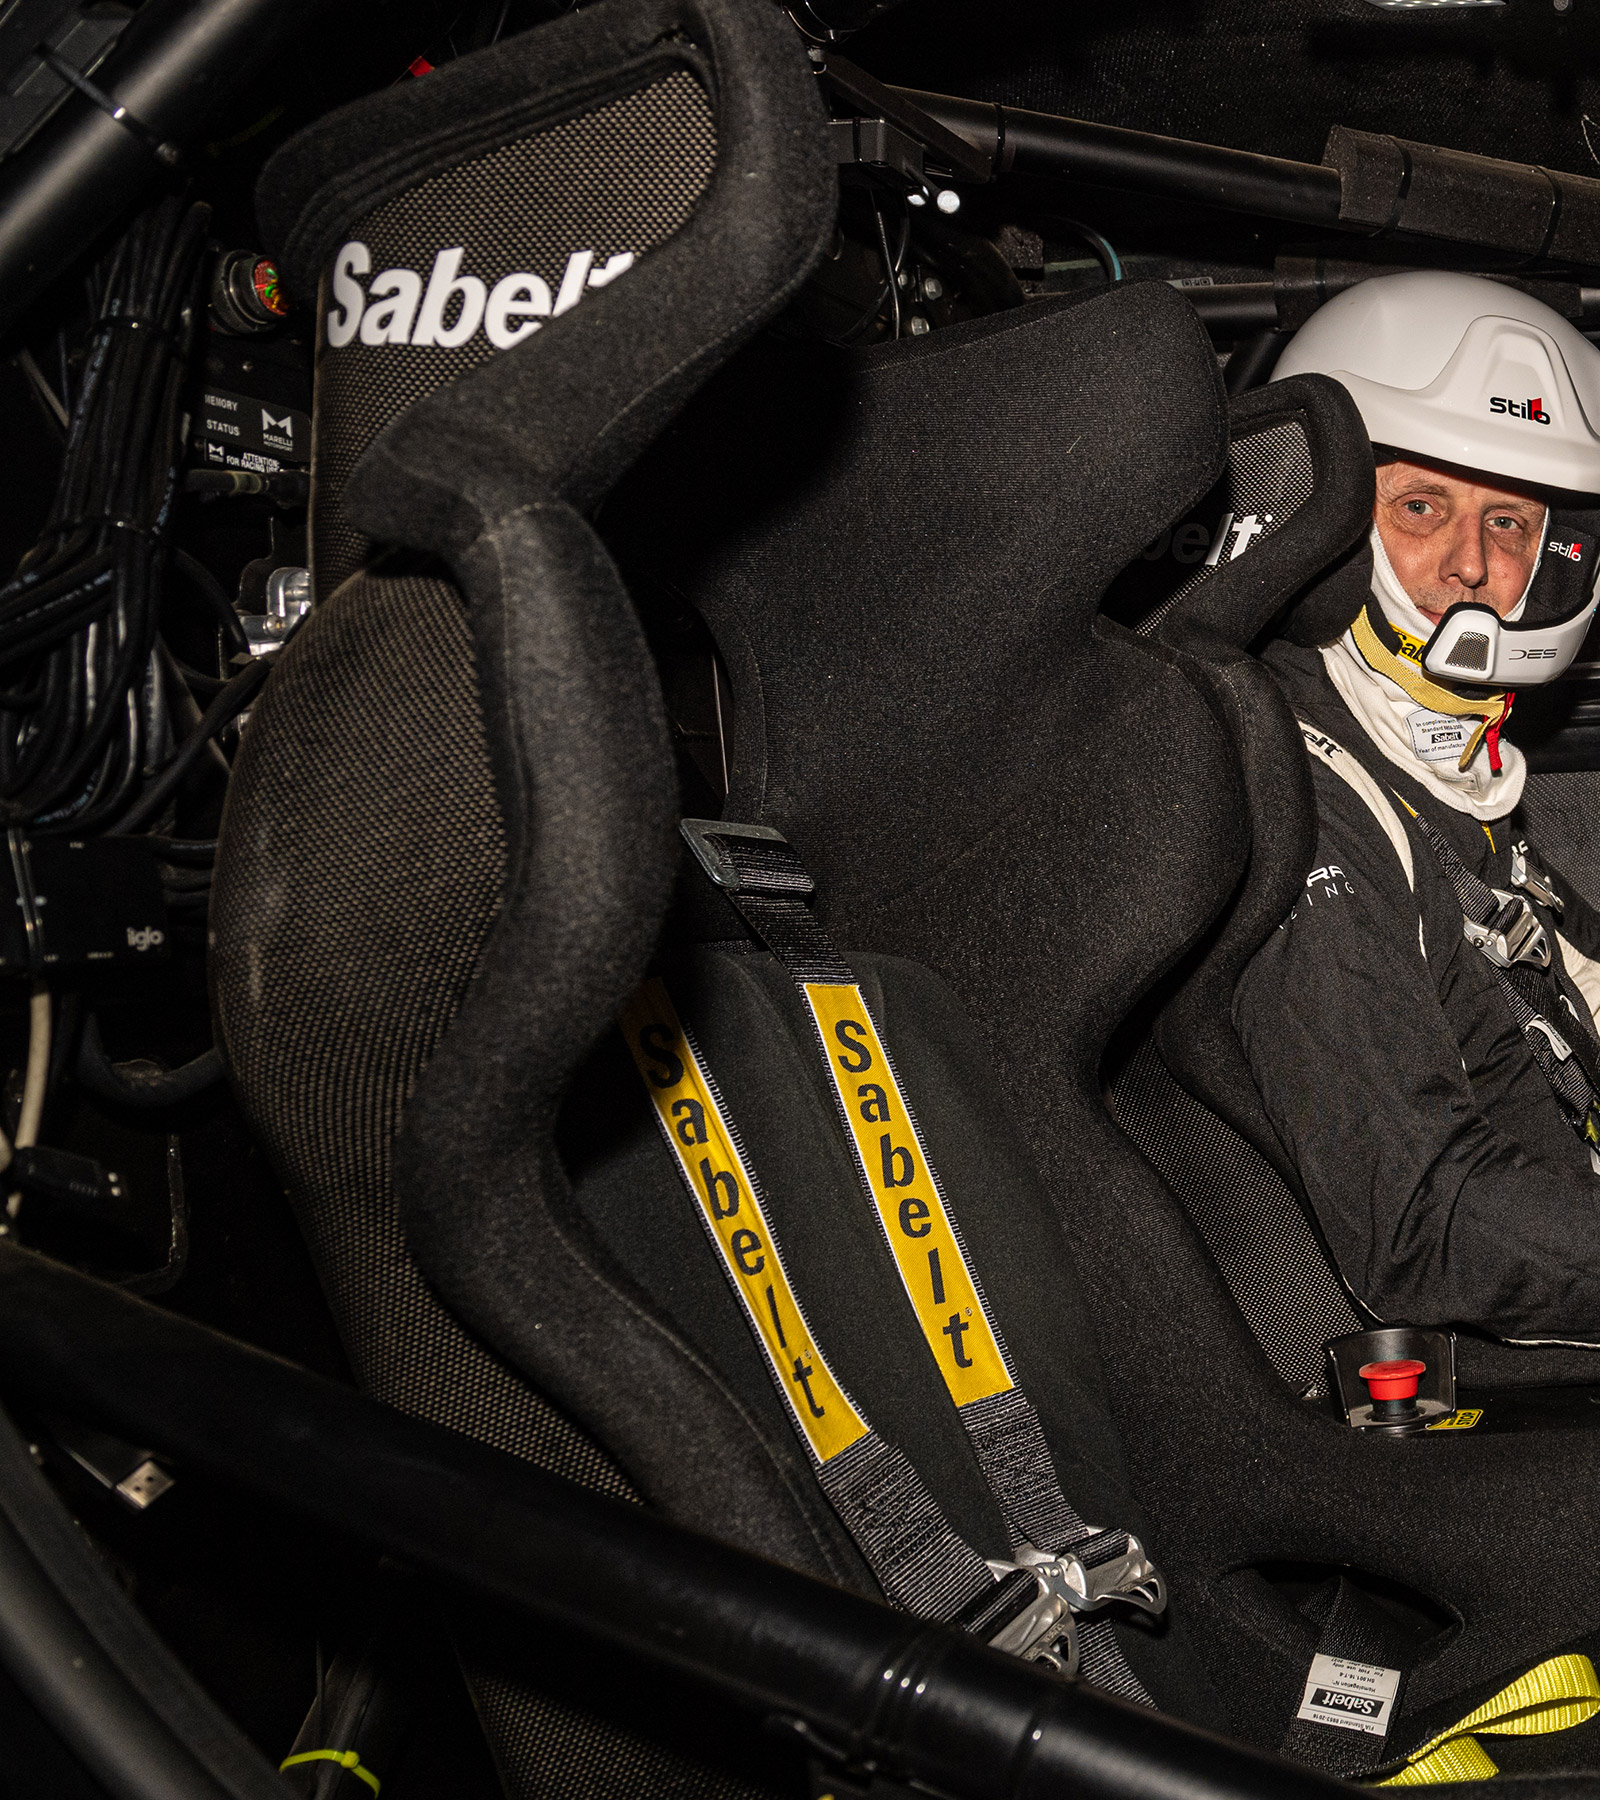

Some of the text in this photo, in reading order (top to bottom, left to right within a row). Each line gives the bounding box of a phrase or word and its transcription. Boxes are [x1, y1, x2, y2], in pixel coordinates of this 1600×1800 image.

[204, 394, 238, 411] MEMORY
[1489, 396, 1551, 425] Stilo
[206, 419, 240, 436] STATUS
[263, 433, 294, 446] MARELLI
[226, 455, 240, 466] FOR
[241, 460, 266, 473] RACING
[1433, 732, 1460, 743] Sabelt
[1340, 1681, 1376, 1692] Homologation
[1322, 1692, 1375, 1715] Sabelt
[1339, 1720, 1364, 1728] Standard
